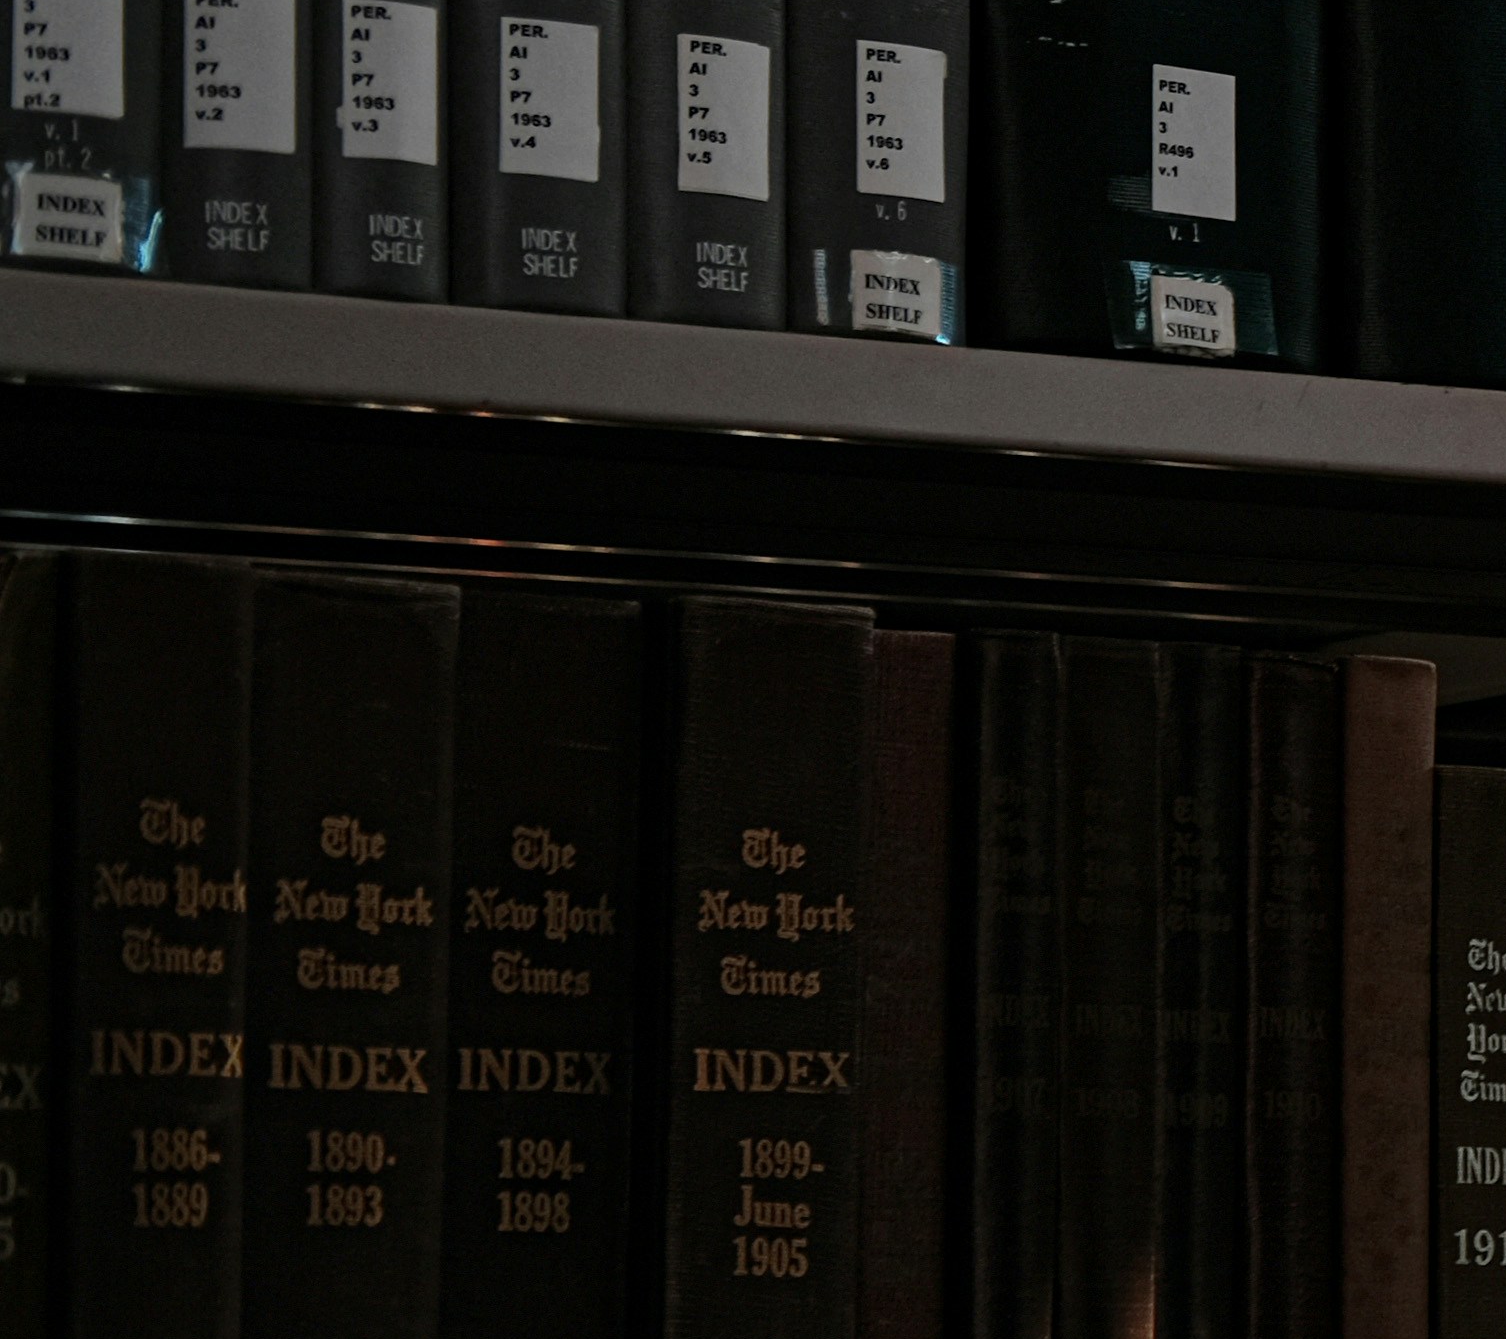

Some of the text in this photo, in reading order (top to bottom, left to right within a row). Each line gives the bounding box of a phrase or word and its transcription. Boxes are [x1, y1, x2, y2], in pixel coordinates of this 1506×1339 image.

[510, 24, 547, 38] PER.
[1159, 80, 1190, 95] PER.
[513, 113, 551, 127] 1963
[512, 136, 536, 148] v.4
[1159, 143, 1194, 158] R496
[1165, 294, 1217, 316] INDEX
[1167, 323, 1218, 343] SHELF
[321, 815, 386, 866] The
[273, 877, 433, 935] New York
[298, 946, 401, 994] Times
[267, 1042, 428, 1094] INDEX
[307, 1129, 396, 1174] 1890-
[306, 1184, 383, 1226] 1893
